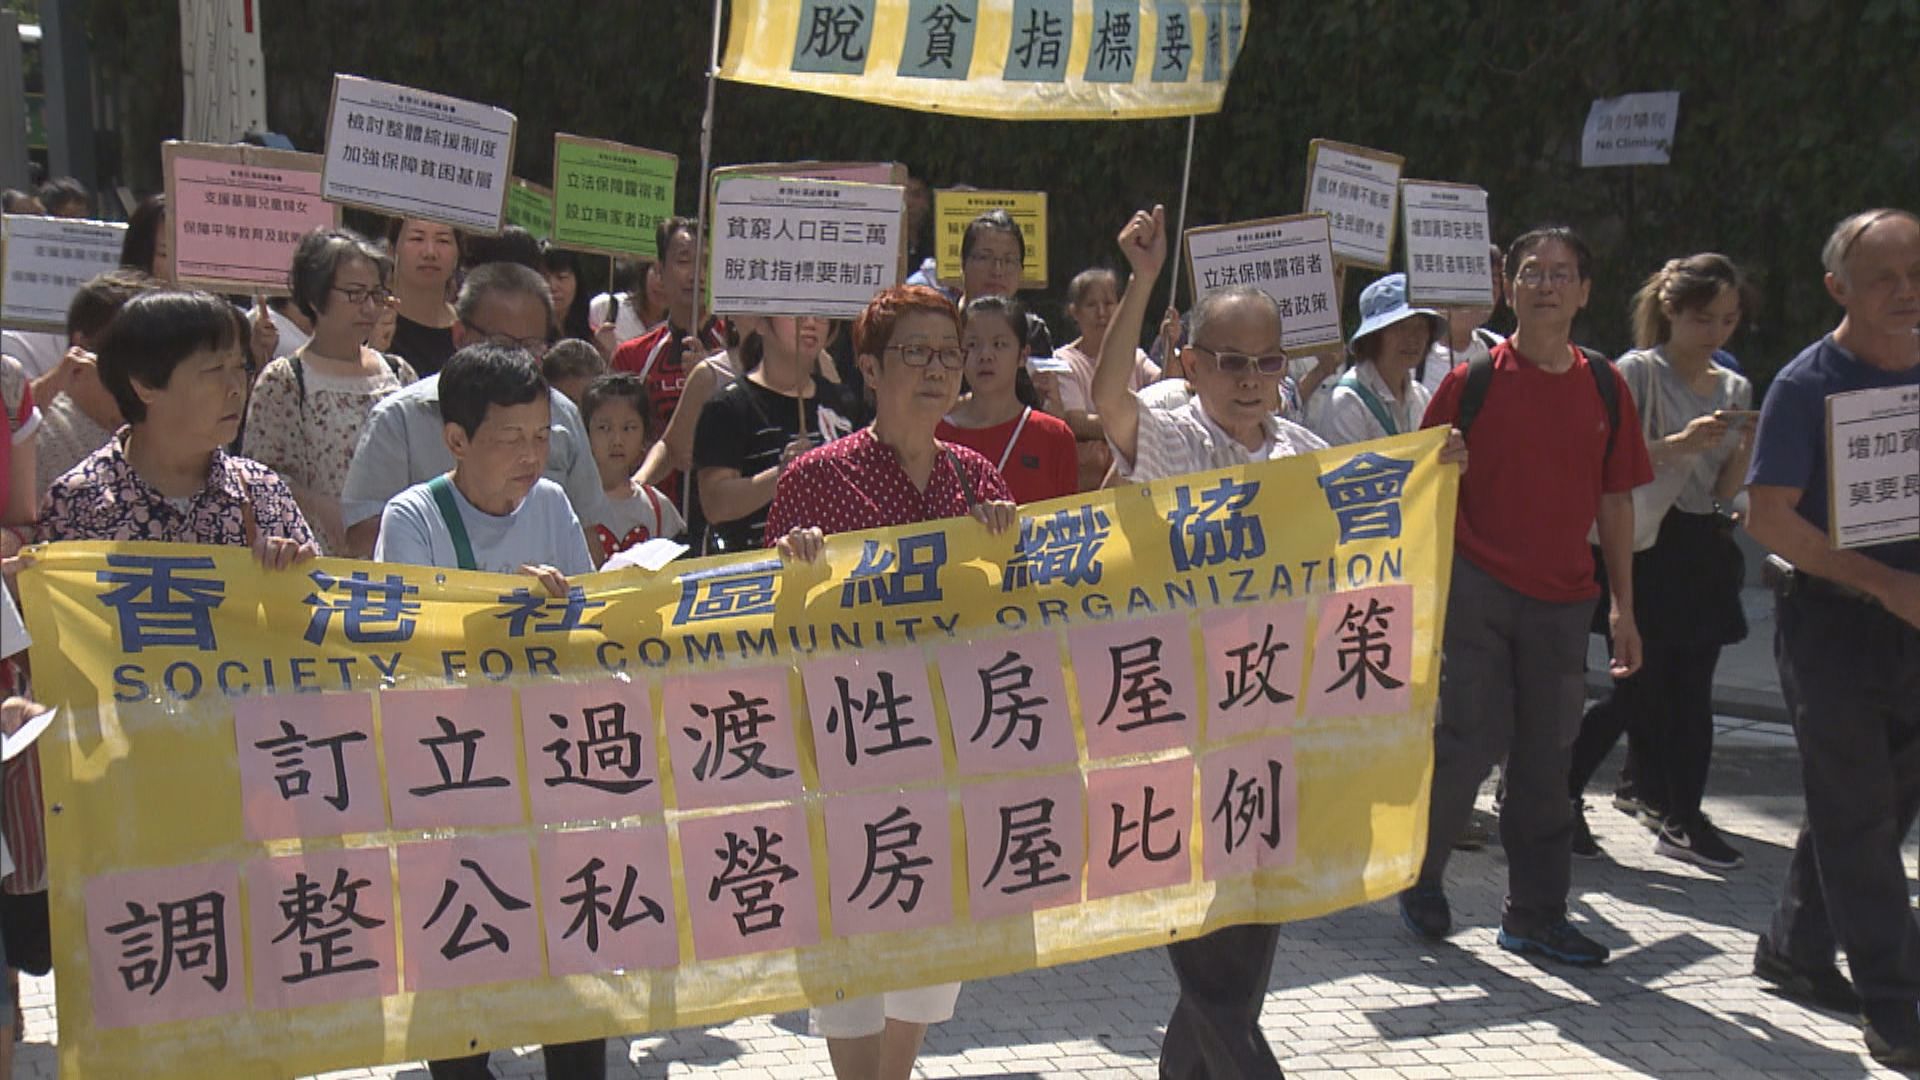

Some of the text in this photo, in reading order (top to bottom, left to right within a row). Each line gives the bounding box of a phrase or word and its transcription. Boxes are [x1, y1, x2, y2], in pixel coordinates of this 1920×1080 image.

[347, 112, 498, 160] 檢討整體綜援制度
[1596, 140, 1613, 150] No
[342, 144, 494, 190] 加強保障貧困基層
[727, 216, 888, 245] 貧窮人口百三萬
[1313, 206, 1386, 240] 全民退休金
[724, 258, 886, 286] 脫貧指標要制訂
[1203, 253, 1323, 290] 立法保障露宿者
[95, 451, 1415, 654] 香港社區組織協會
[111, 547, 1404, 703] SOCIETY FOR COMMUNITY ORGANIZATION
[254, 598, 1405, 812] 訂立過渡性房屋政策
[105, 759, 1284, 996] 調整公私營房屋比例
